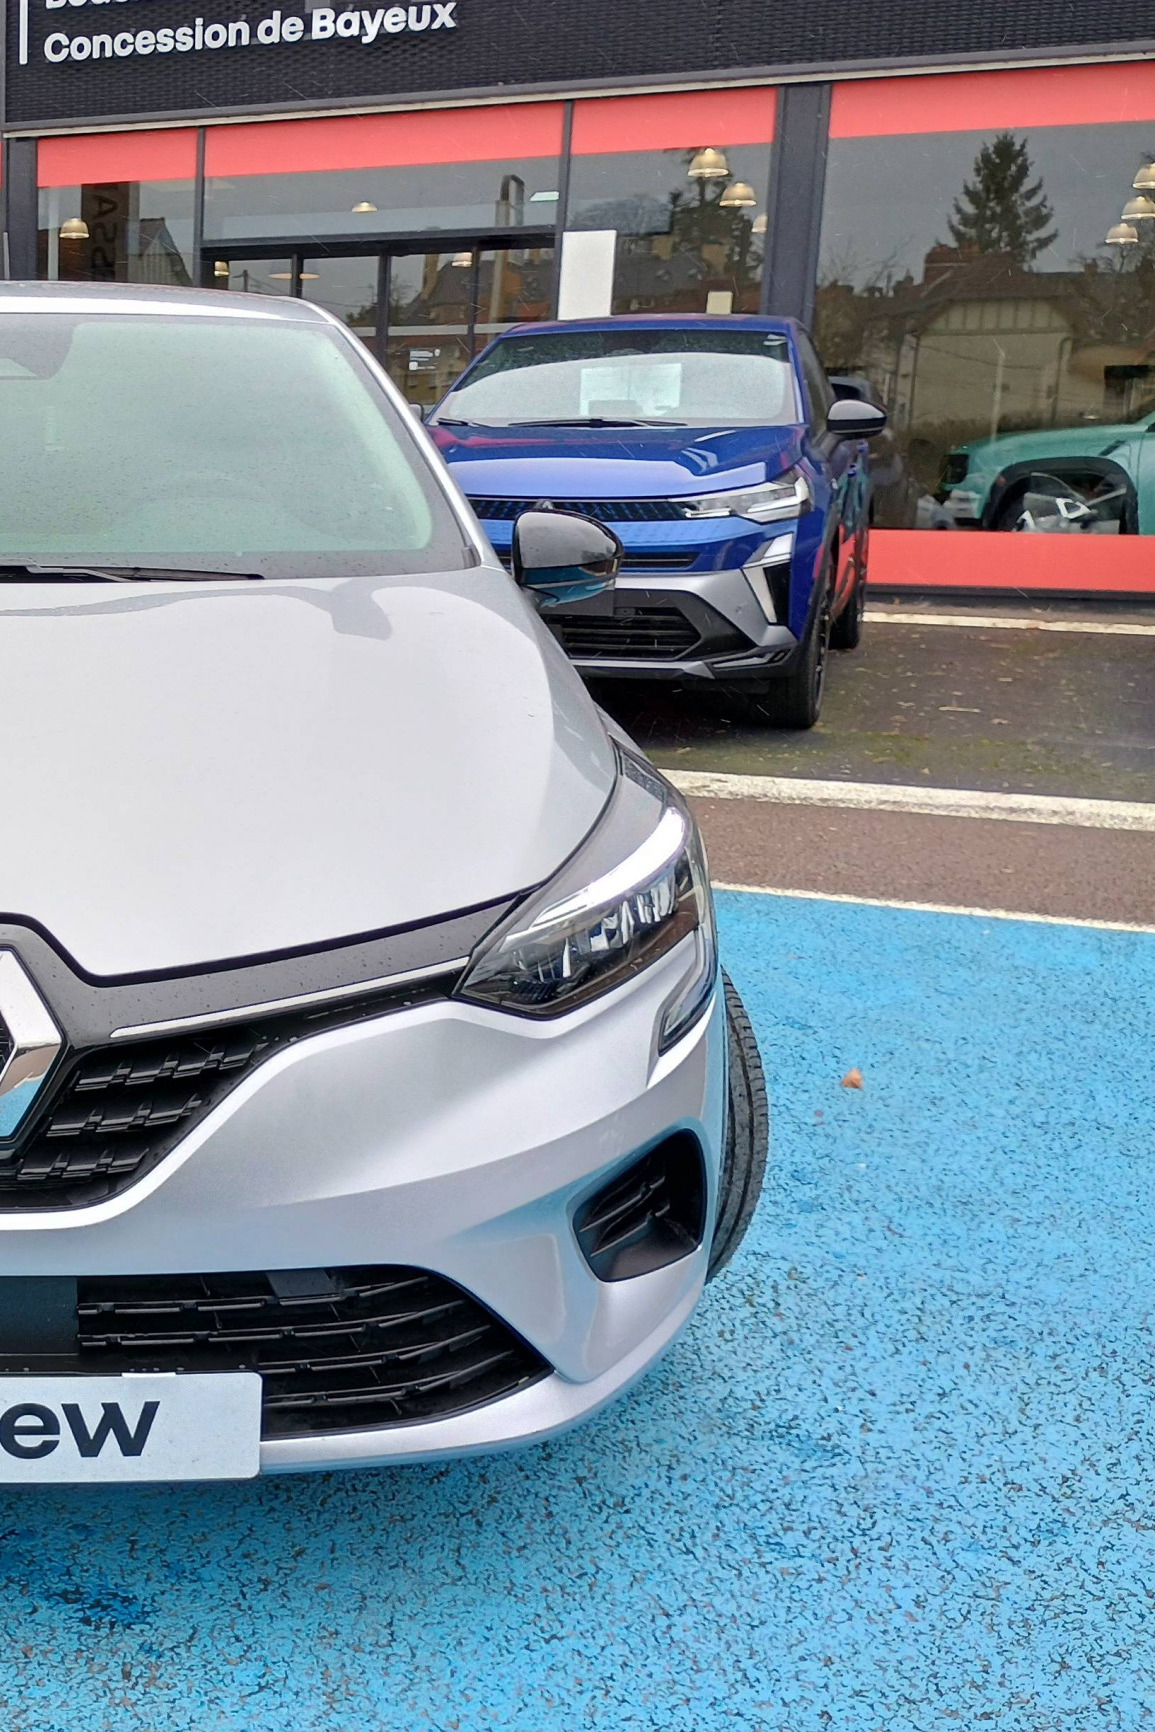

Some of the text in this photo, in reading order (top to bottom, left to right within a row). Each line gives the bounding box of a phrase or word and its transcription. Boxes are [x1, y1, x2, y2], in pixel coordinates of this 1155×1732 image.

[44, 2, 458, 63] Concession de Bayeux
